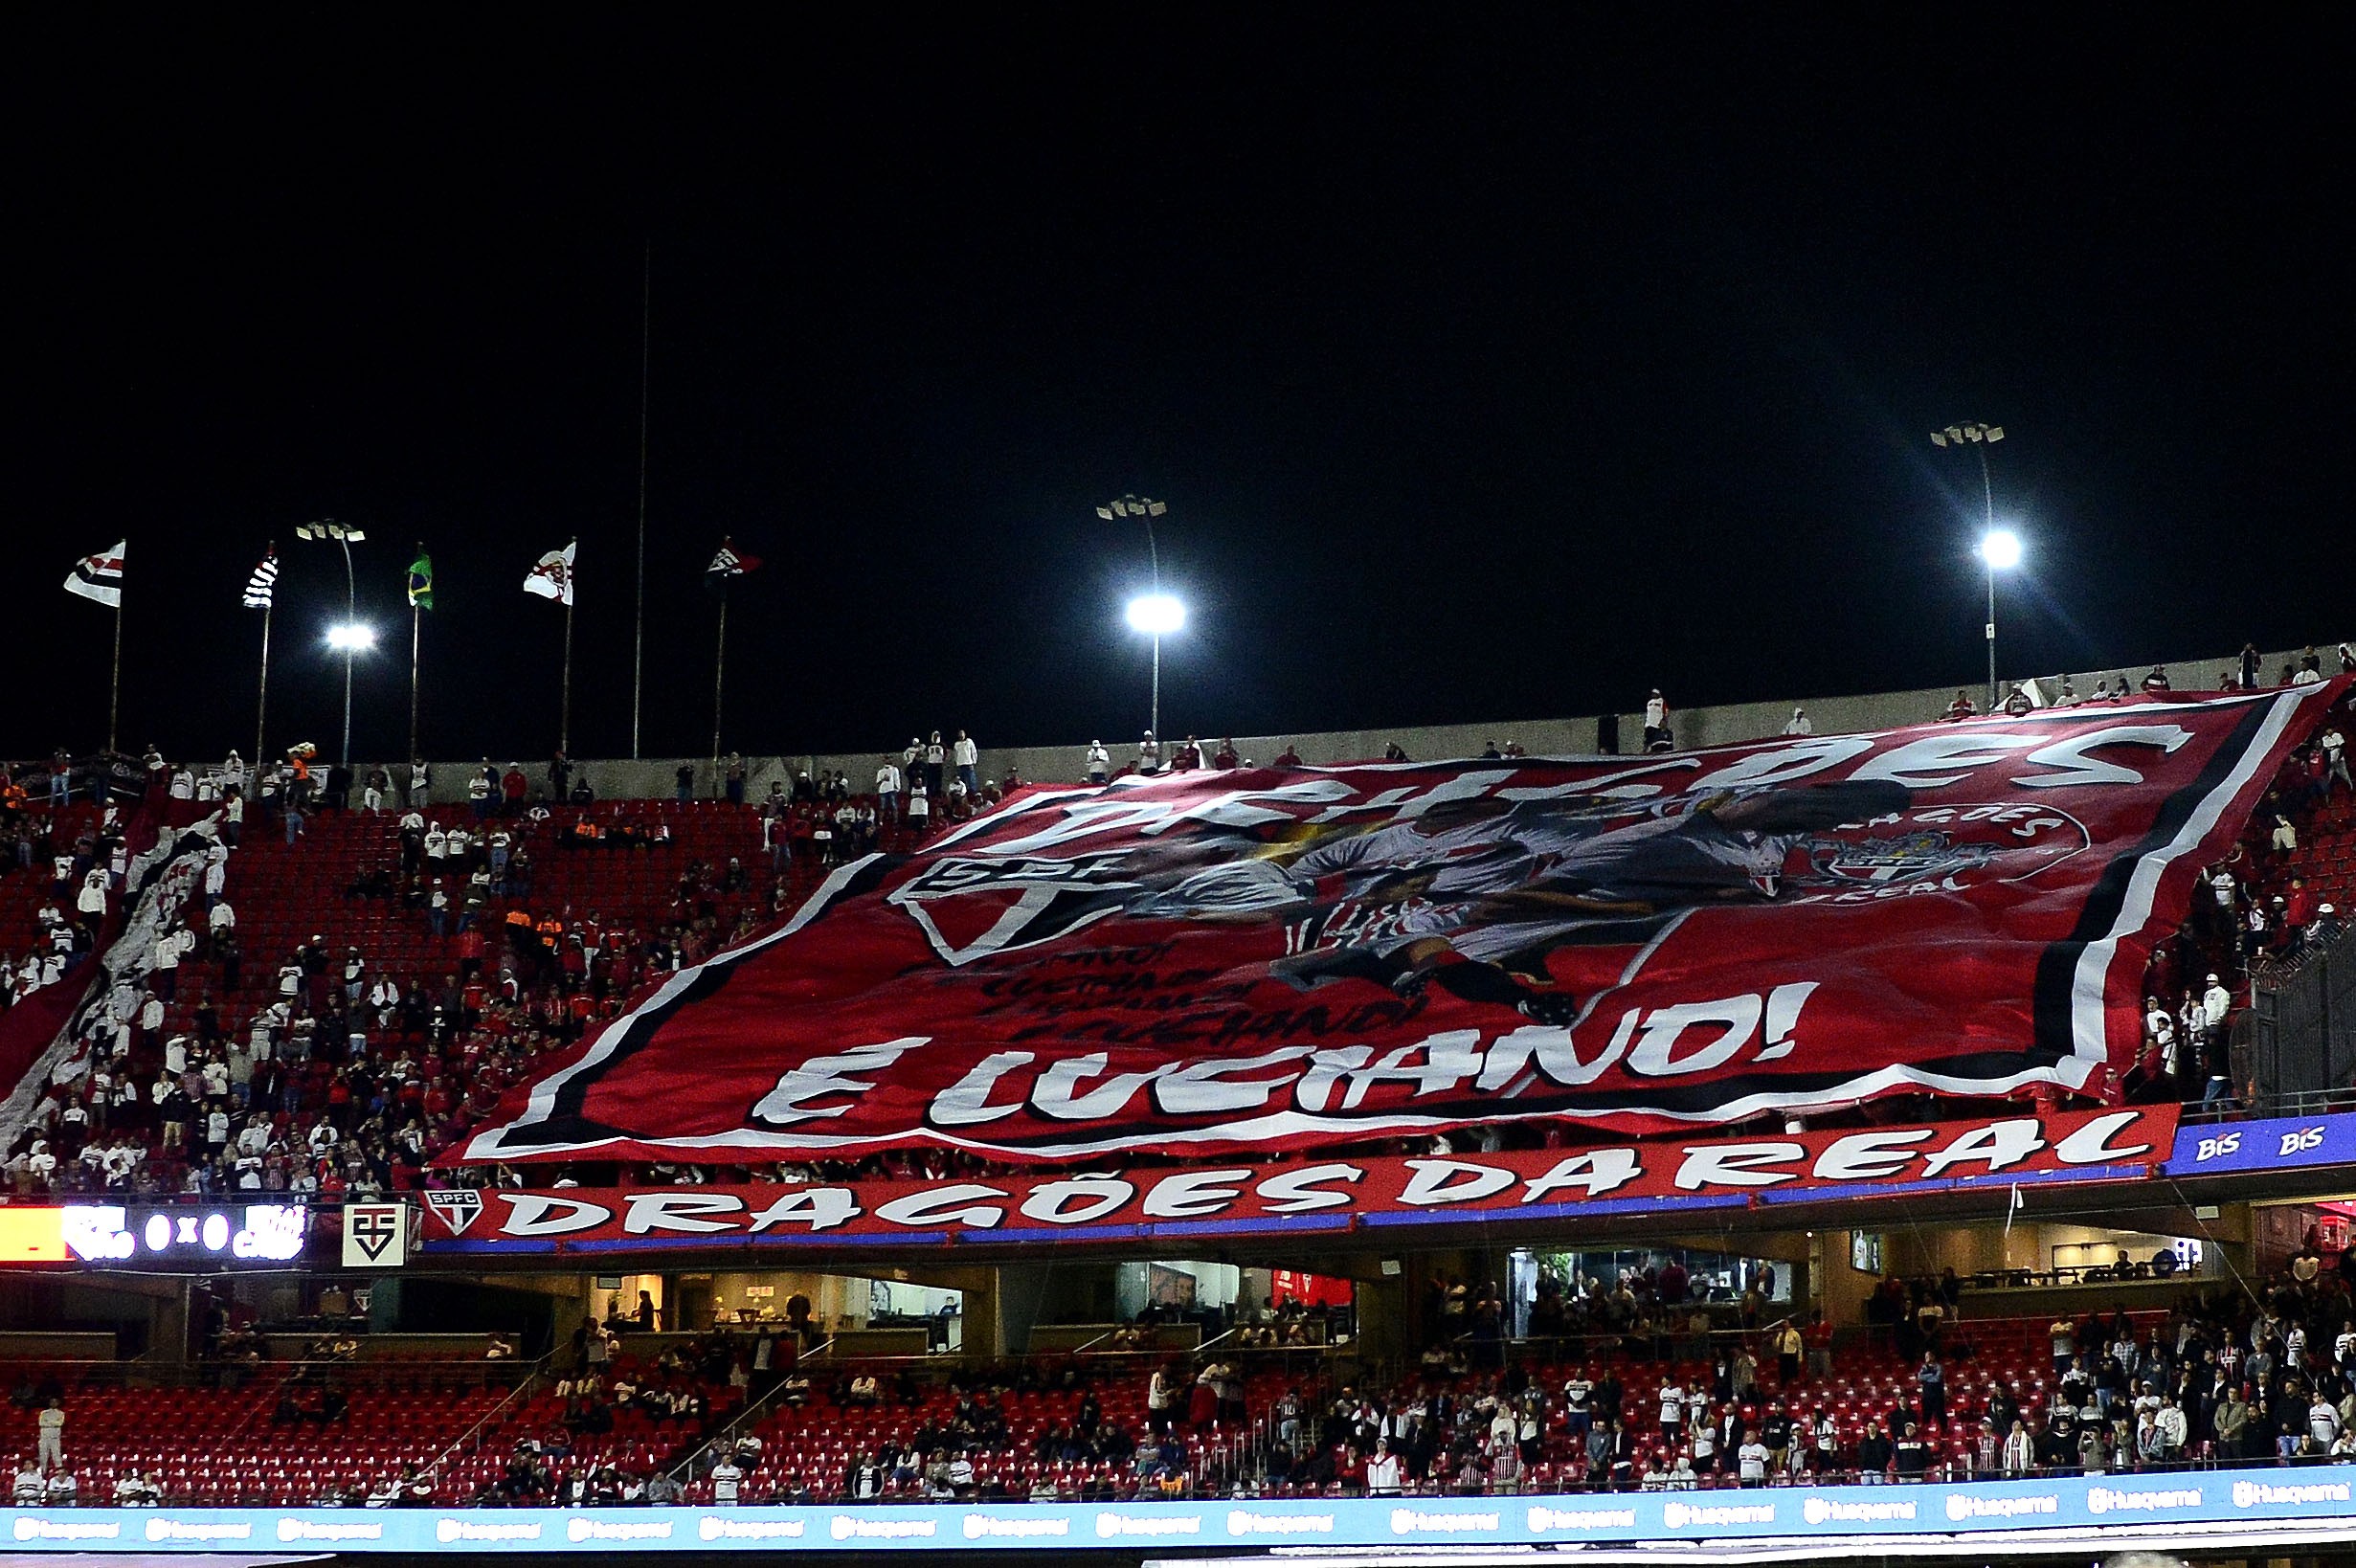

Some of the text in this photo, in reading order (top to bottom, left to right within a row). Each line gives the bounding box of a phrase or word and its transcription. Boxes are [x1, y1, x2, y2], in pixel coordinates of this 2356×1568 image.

[930, 982, 1820, 1124] LUCIANO!
[499, 1110, 2150, 1235] DRAGÕES DA REAL
[431, 1193, 477, 1203] SPFC
[2106, 1490, 2201, 1511] Husqvarna
[2253, 1484, 2348, 1506] Husqvarna
